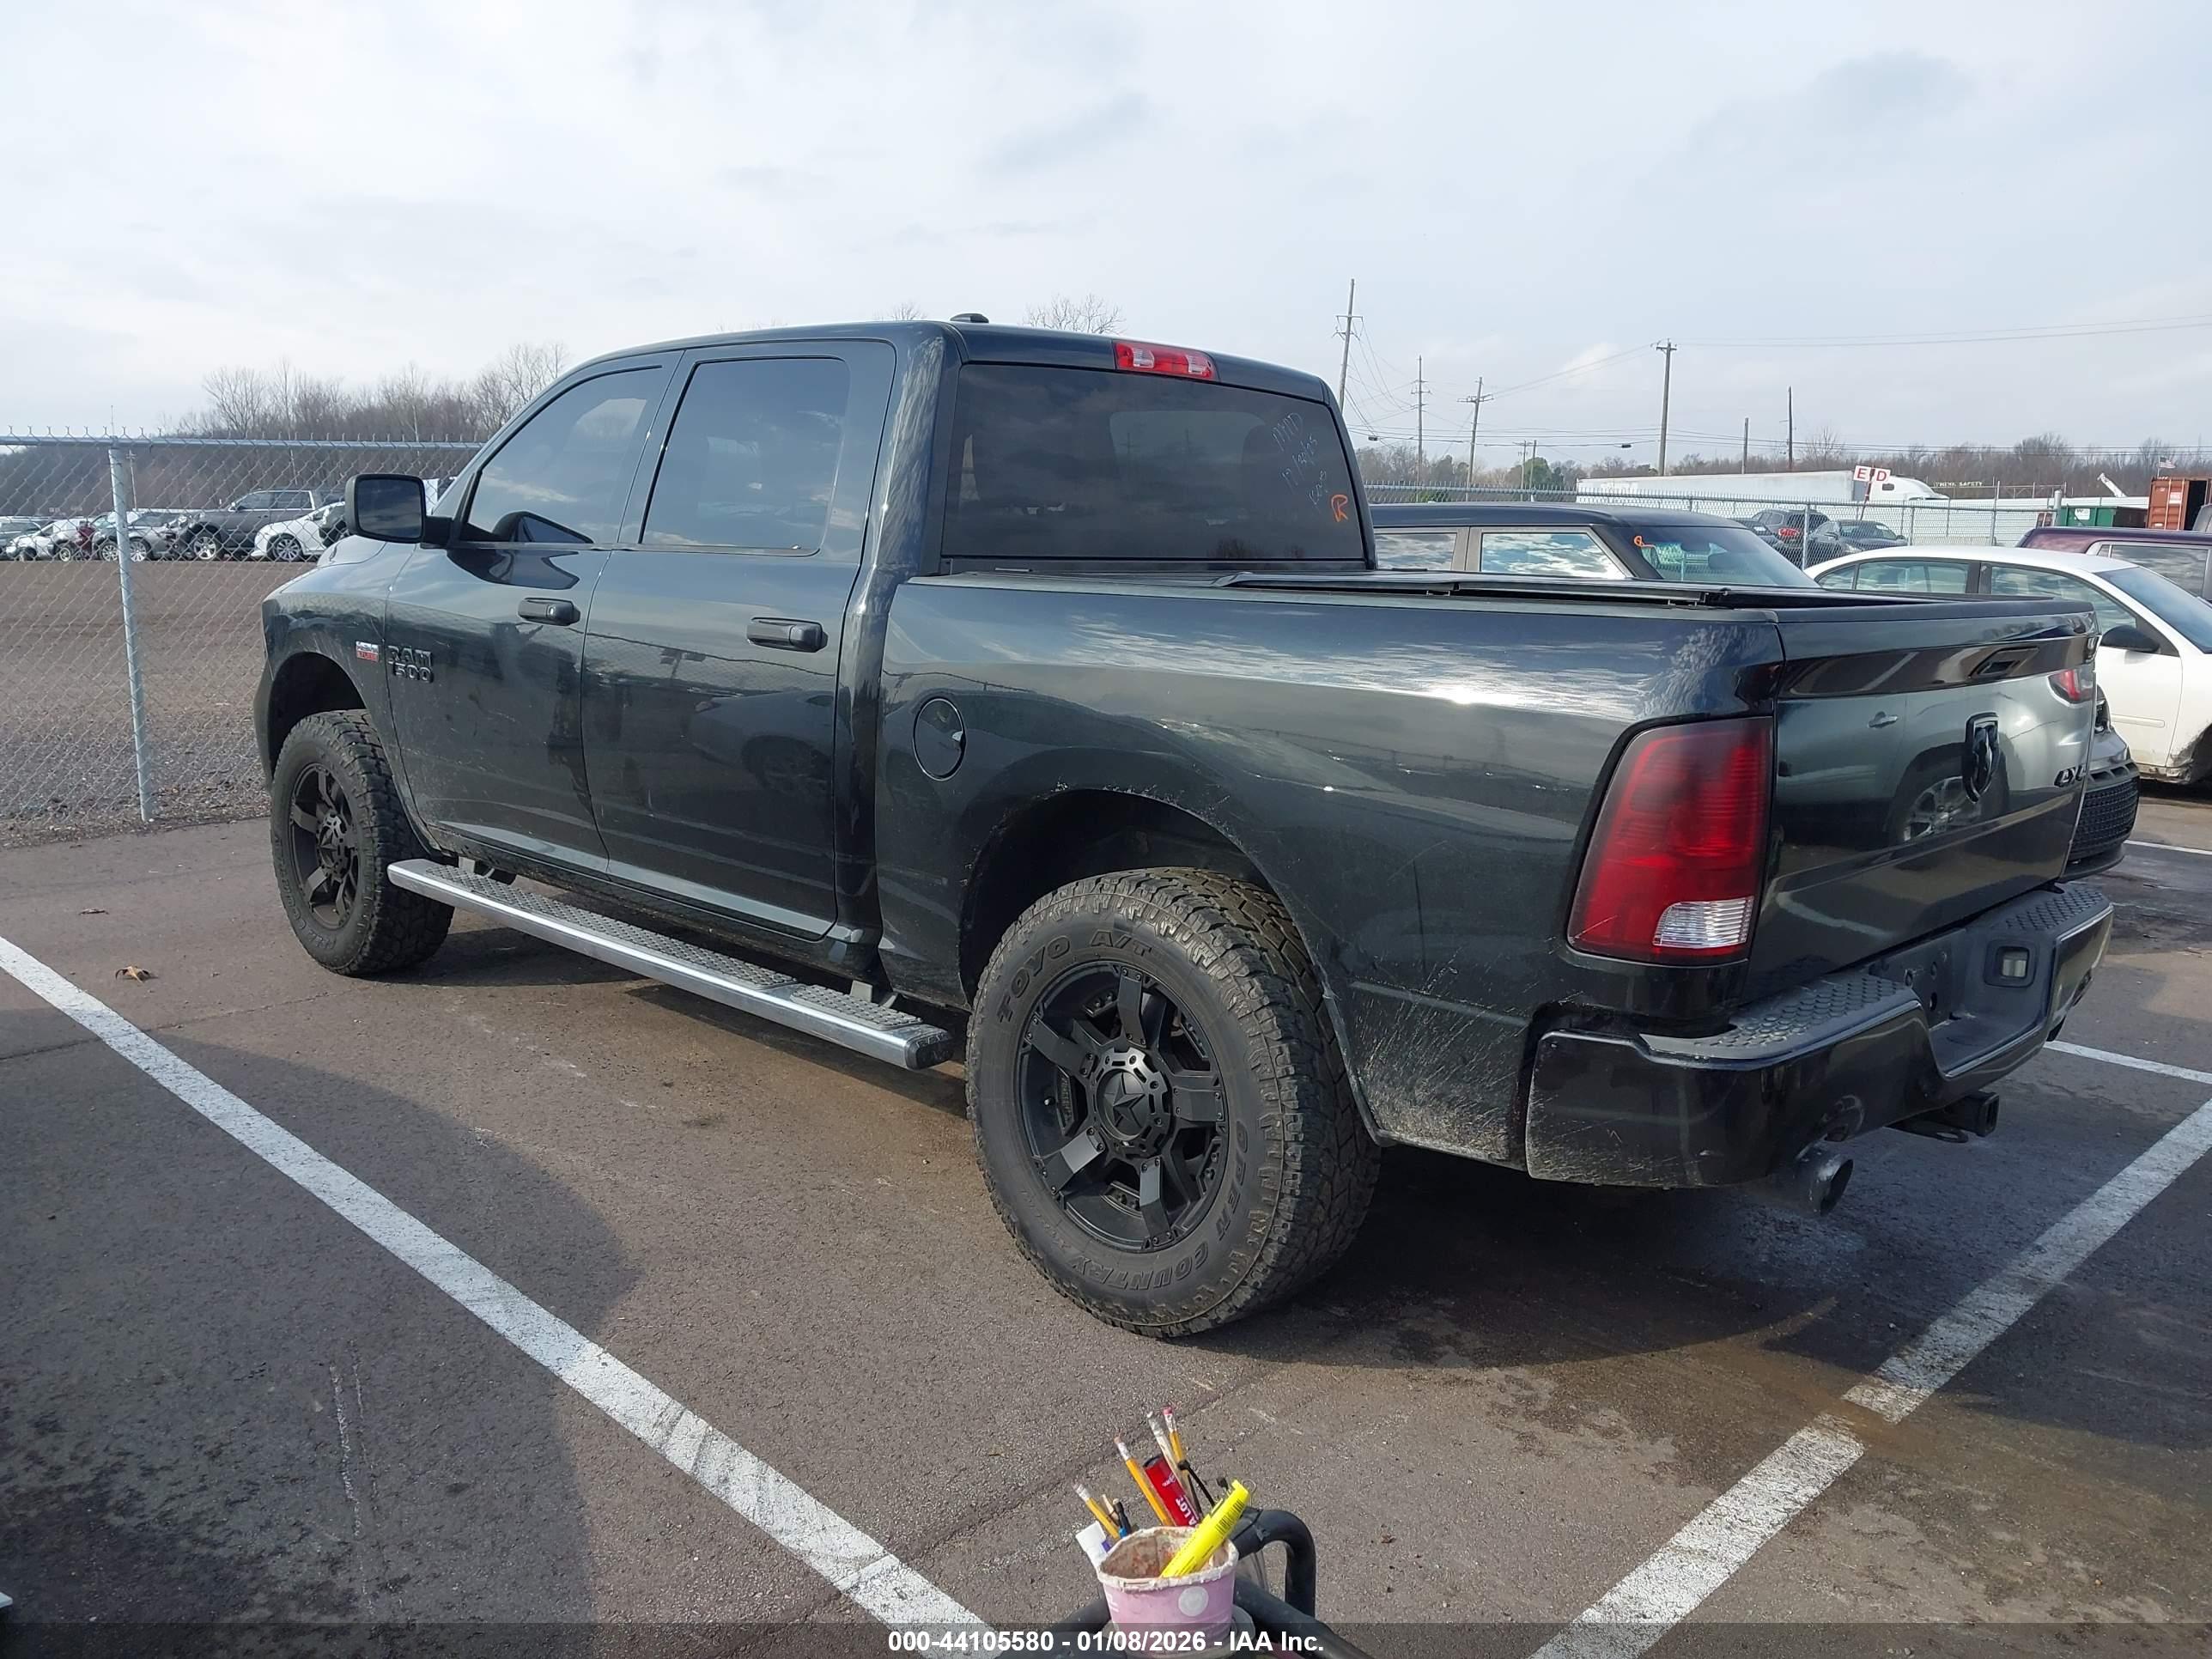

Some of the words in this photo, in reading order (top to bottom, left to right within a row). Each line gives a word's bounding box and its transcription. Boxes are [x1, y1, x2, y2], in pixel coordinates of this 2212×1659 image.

[1857, 468, 1867, 479] E
[1876, 470, 1887, 482] D
[1331, 494, 1348, 522] R
[387, 645, 433, 668] RAM
[996, 934, 1071, 1024] TOYO
[1216, 1121, 1249, 1242] OPEN
[1072, 1244, 1210, 1291] COUNTRY
